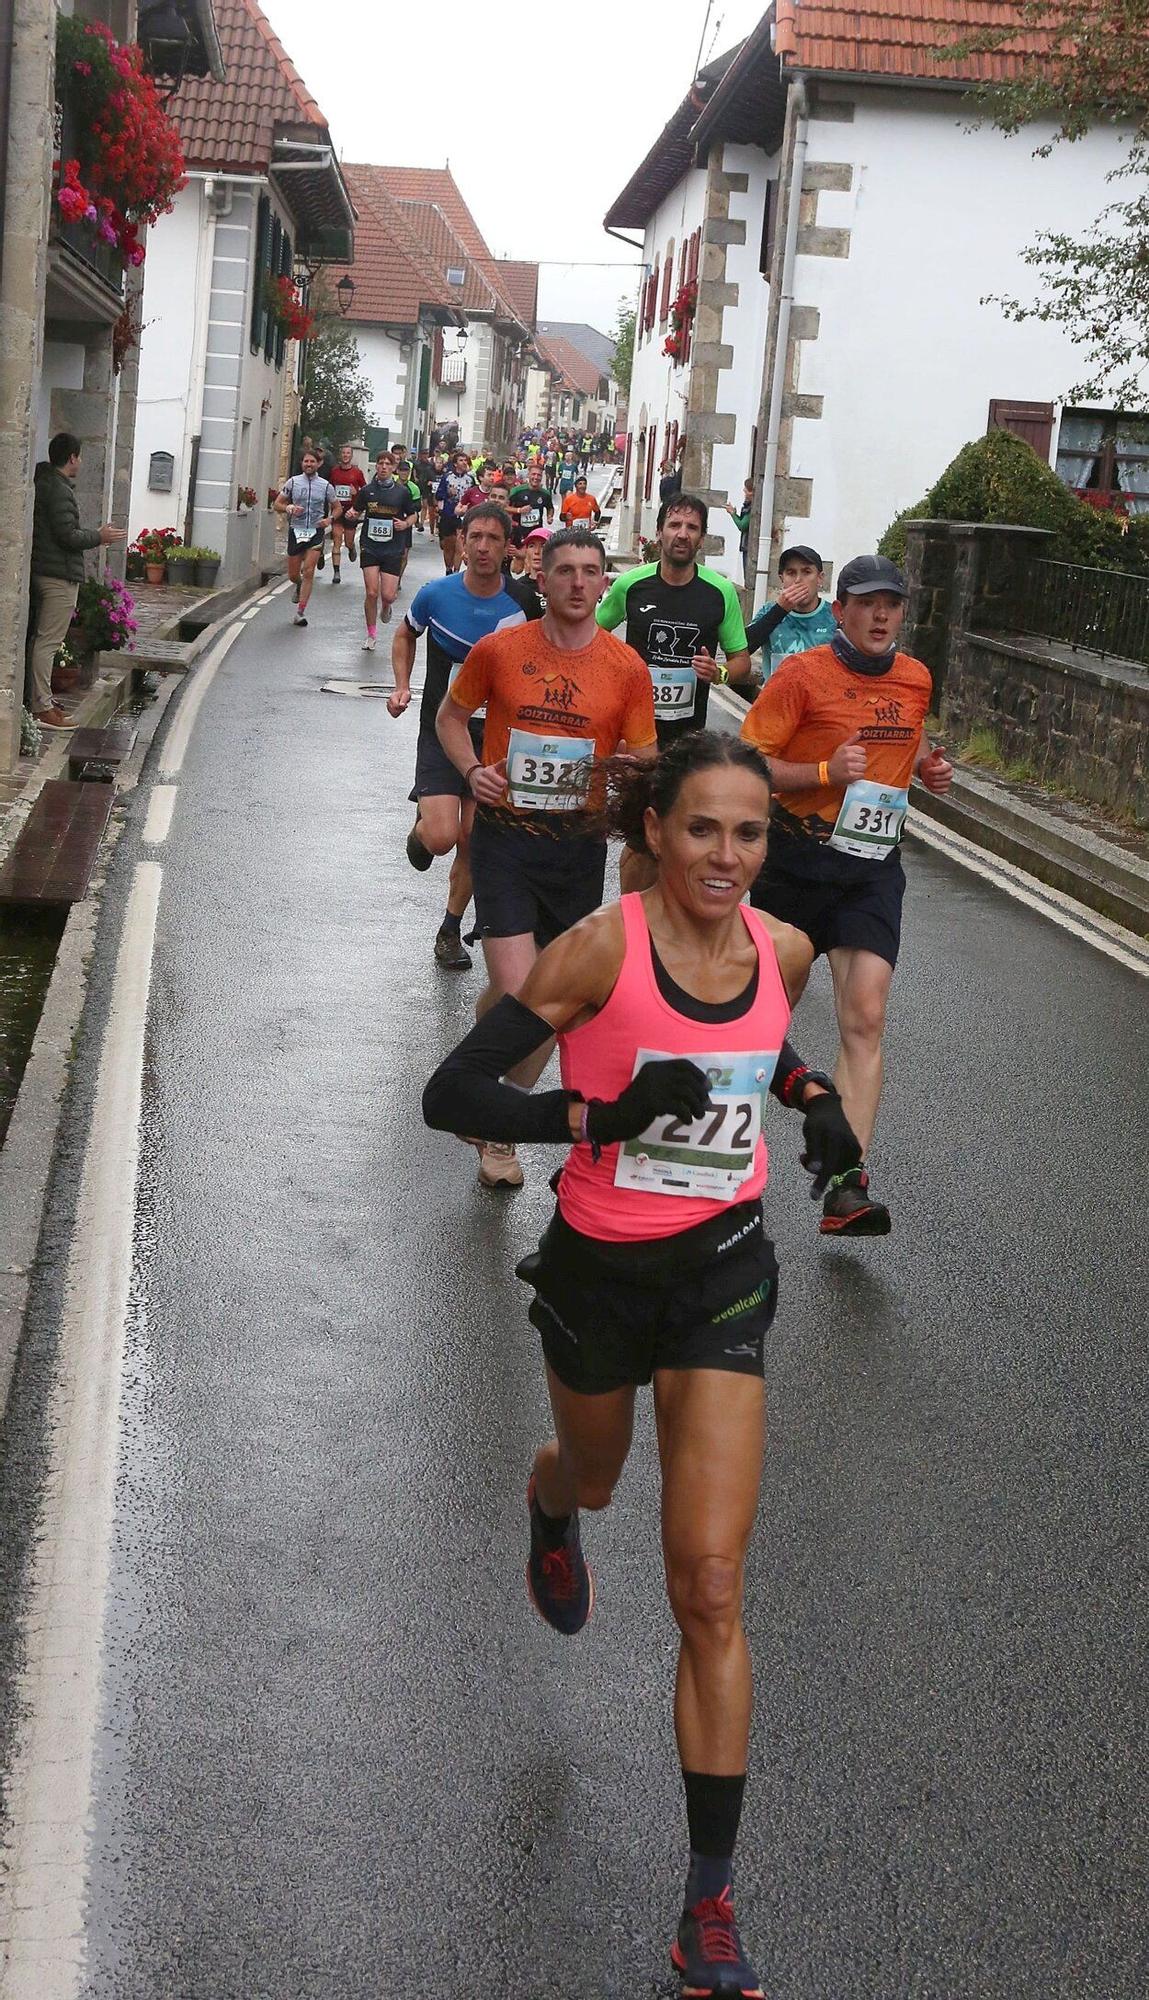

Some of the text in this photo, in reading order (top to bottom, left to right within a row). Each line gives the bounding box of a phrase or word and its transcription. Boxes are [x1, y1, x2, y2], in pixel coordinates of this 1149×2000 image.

[373, 526, 388, 535] 868
[854, 807, 894, 835] 331
[661, 1103, 753, 1150] 272
[716, 1215, 761, 1253] MARLOAR
